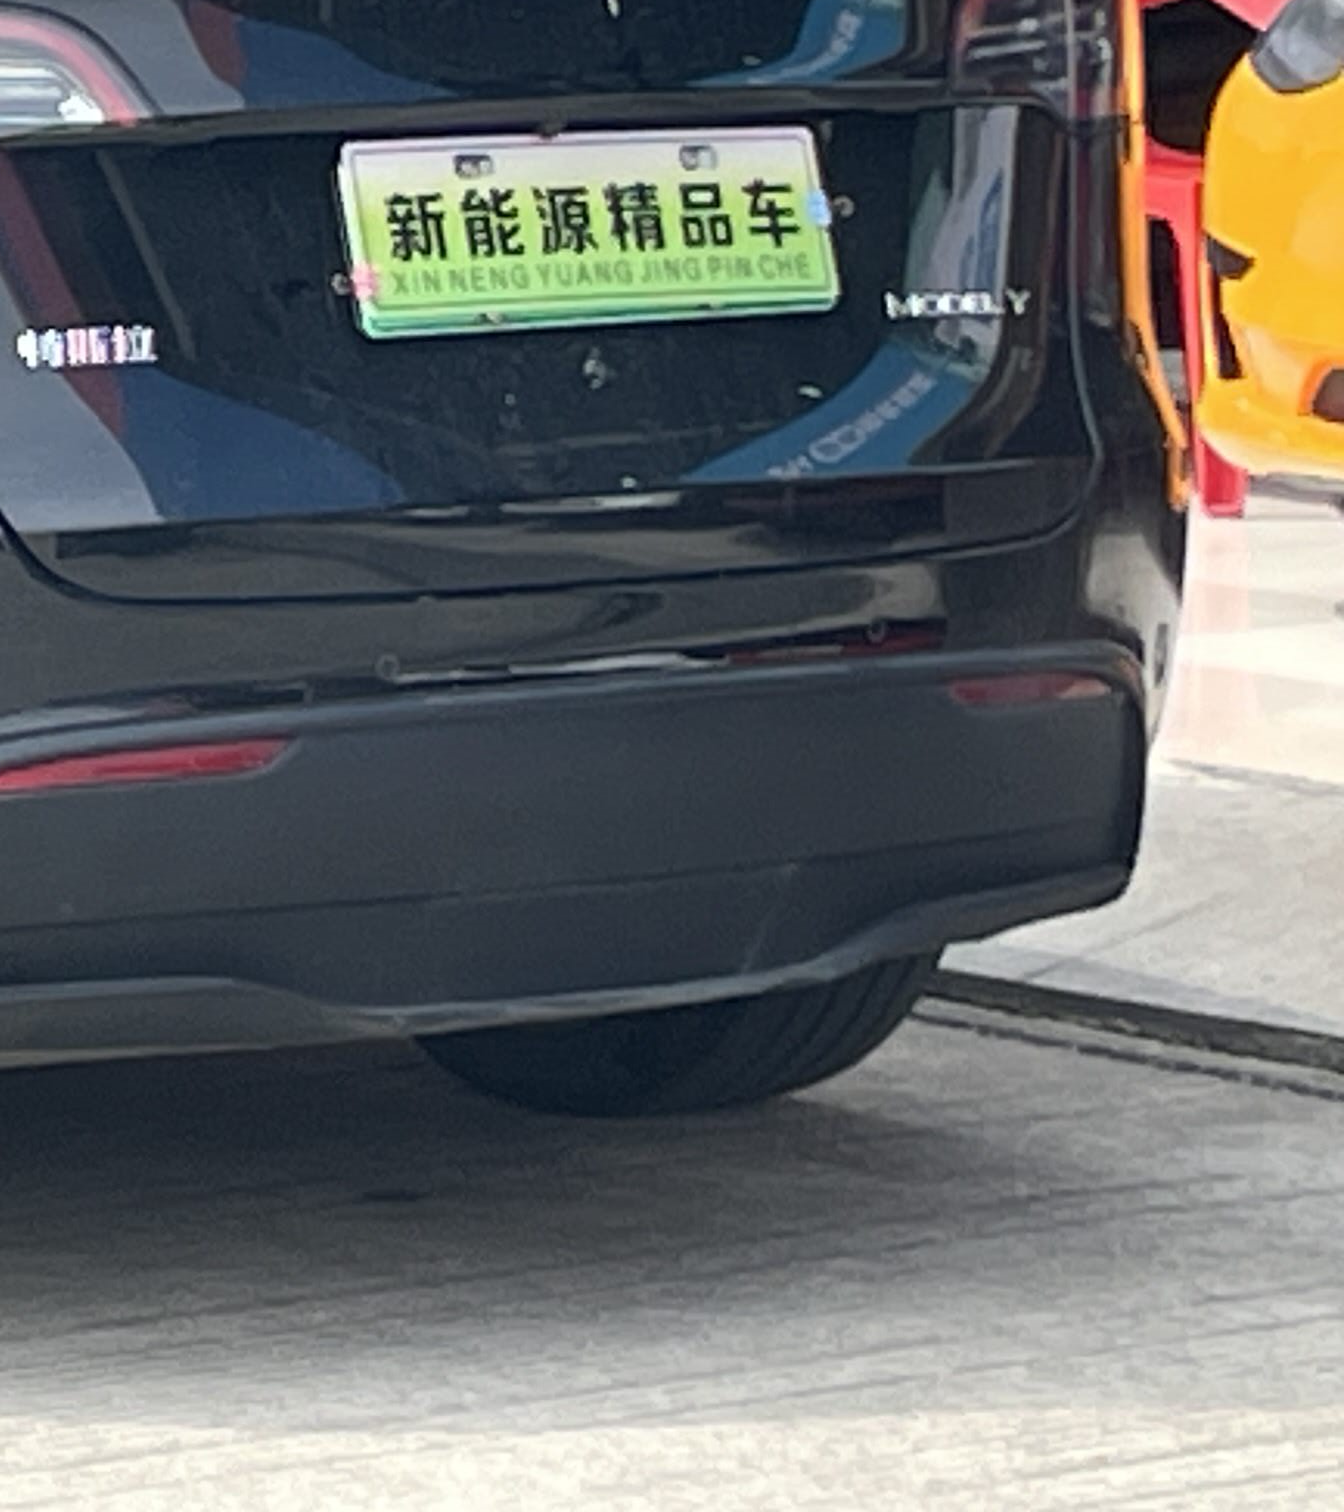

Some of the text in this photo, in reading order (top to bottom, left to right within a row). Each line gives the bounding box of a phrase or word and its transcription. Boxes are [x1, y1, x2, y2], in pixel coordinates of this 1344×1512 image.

[383, 178, 802, 262] 新能源精品车
[391, 252, 812, 295] XIN NENG YUANG JING PIN CHE
[884, 289, 1032, 319] MODEL Y
